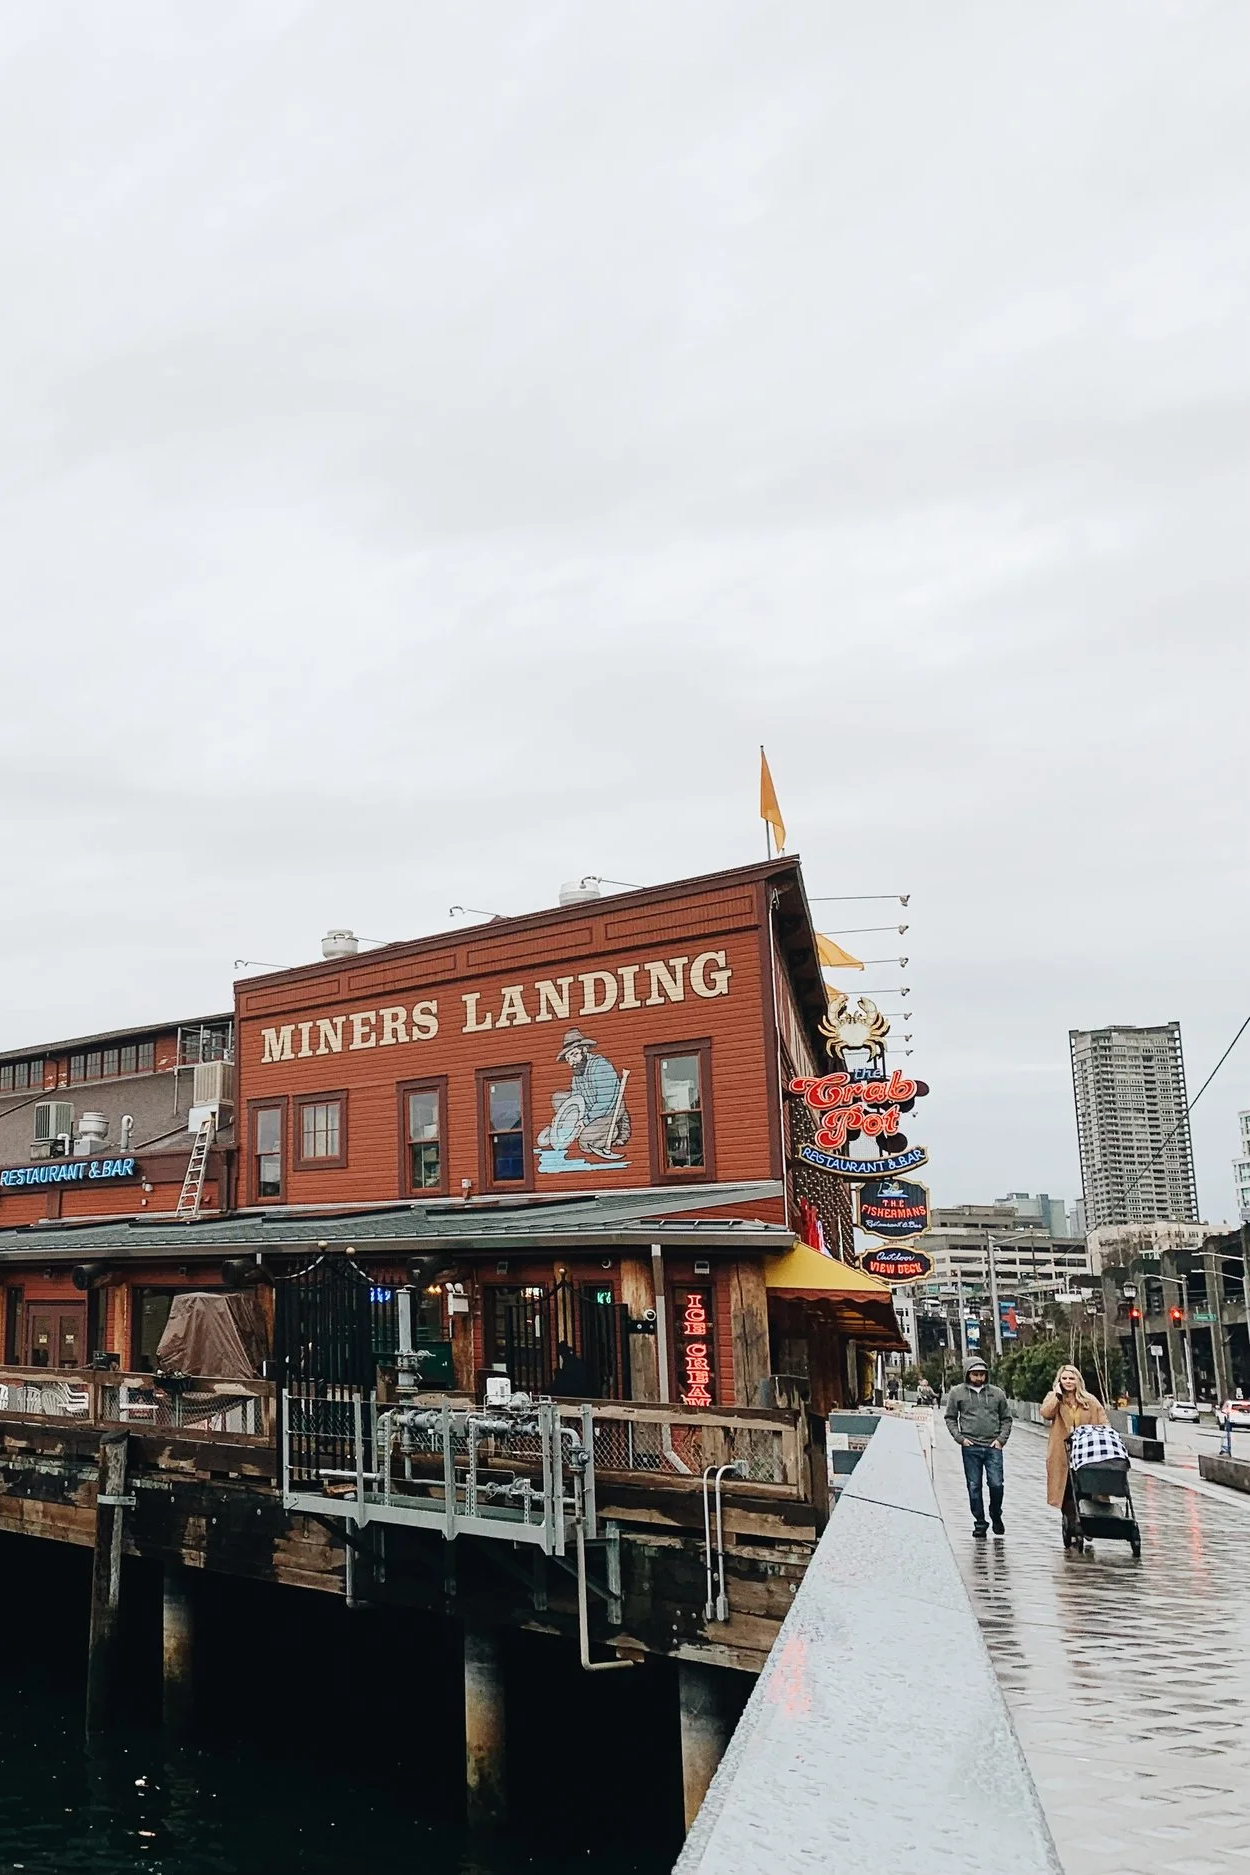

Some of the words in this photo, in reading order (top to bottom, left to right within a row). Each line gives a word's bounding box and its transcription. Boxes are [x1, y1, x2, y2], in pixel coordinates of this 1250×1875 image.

[260, 1000, 440, 1064] MINERS
[461, 950, 732, 1034] LANDING
[854, 1068, 881, 1080] the
[789, 1070, 917, 1110] Crab
[815, 1102, 900, 1150] Pot
[802, 1147, 885, 1173] RESTAURANT
[0, 1162, 88, 1187] RESTAURANT
[861, 1204, 927, 1219] FISHERMANS
[870, 1261, 895, 1275] VIEW
[897, 1263, 923, 1275] DECK
[876, 1251, 915, 1261] Outdoor
[684, 1294, 706, 1335] ICE
[684, 1343, 712, 1407] CREAM
